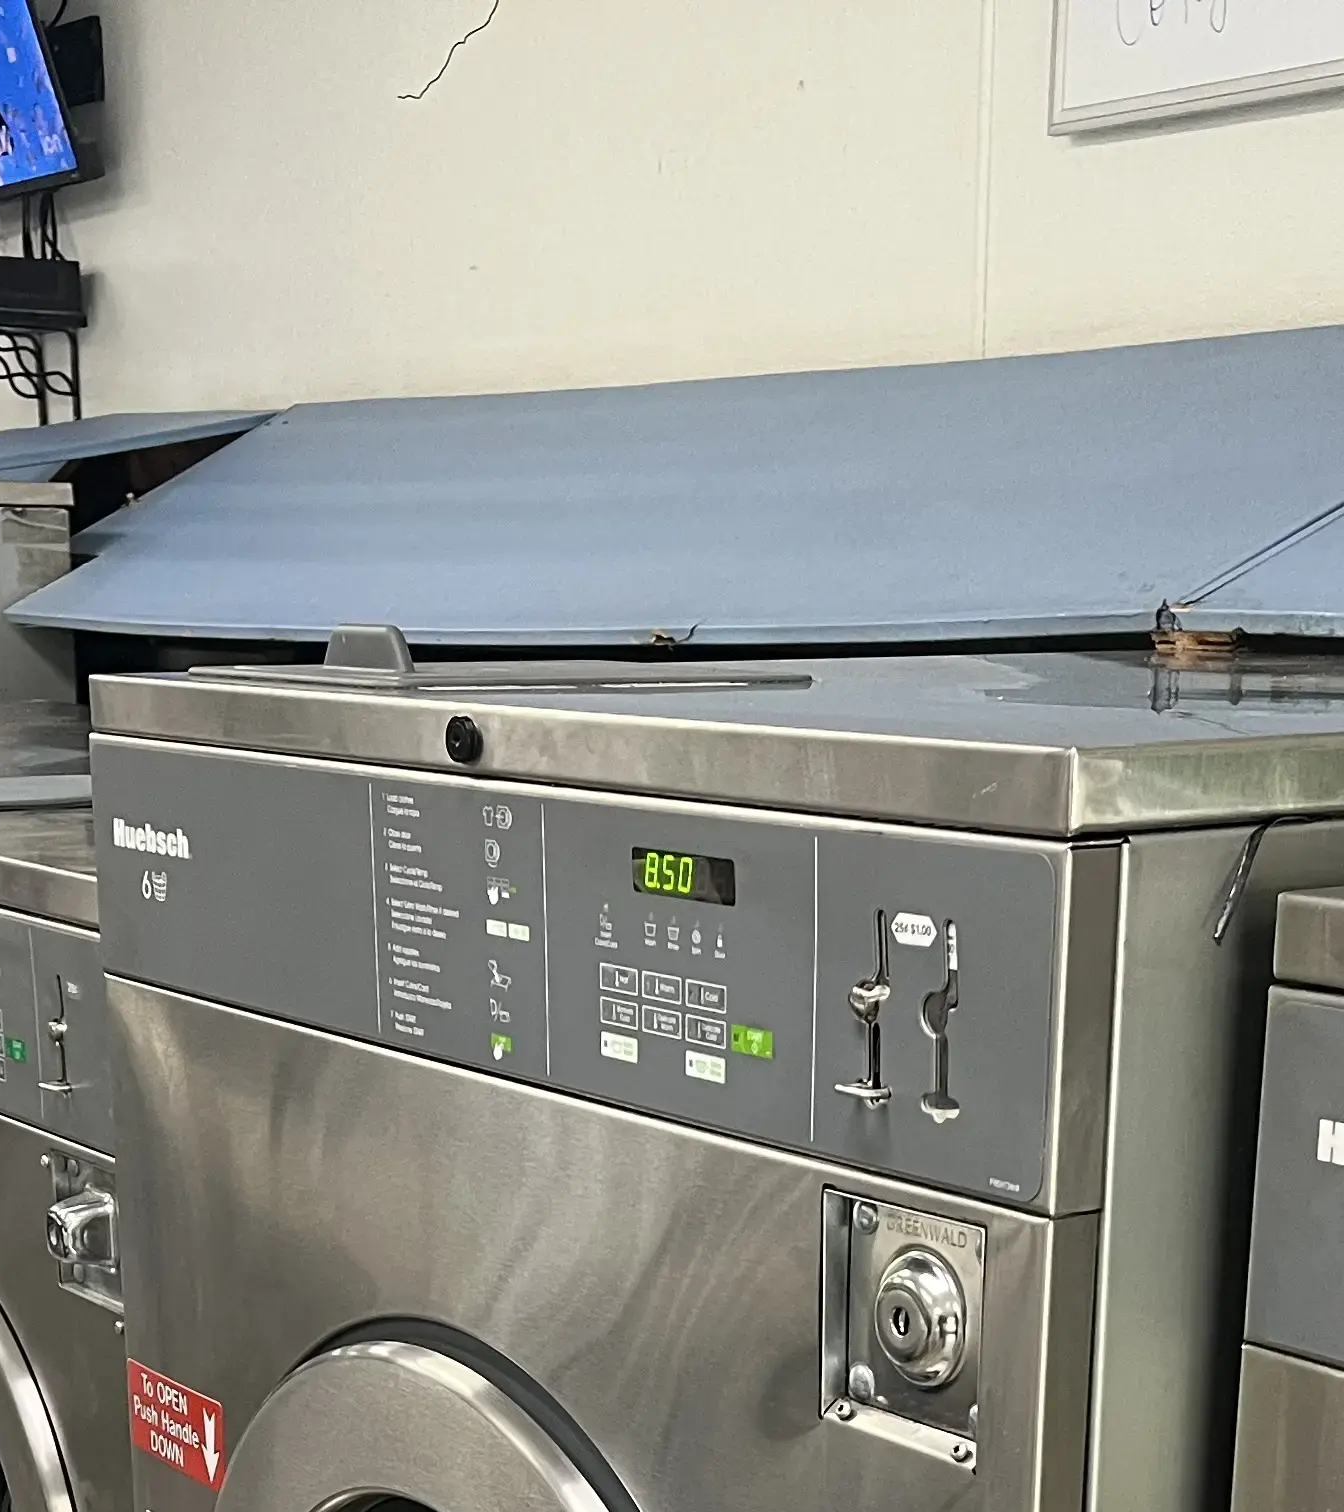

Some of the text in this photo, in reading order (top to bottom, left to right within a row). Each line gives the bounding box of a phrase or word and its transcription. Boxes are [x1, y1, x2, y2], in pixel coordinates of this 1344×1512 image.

[113, 817, 190, 859] Huebsch
[142, 870, 152, 900] 6
[645, 852, 693, 894] 8.50
[886, 1212, 968, 1248] GREENWALD
[140, 1372, 188, 1416] To OPEN
[133, 1394, 200, 1449] Push Handle
[150, 1429, 185, 1468] DOWN
